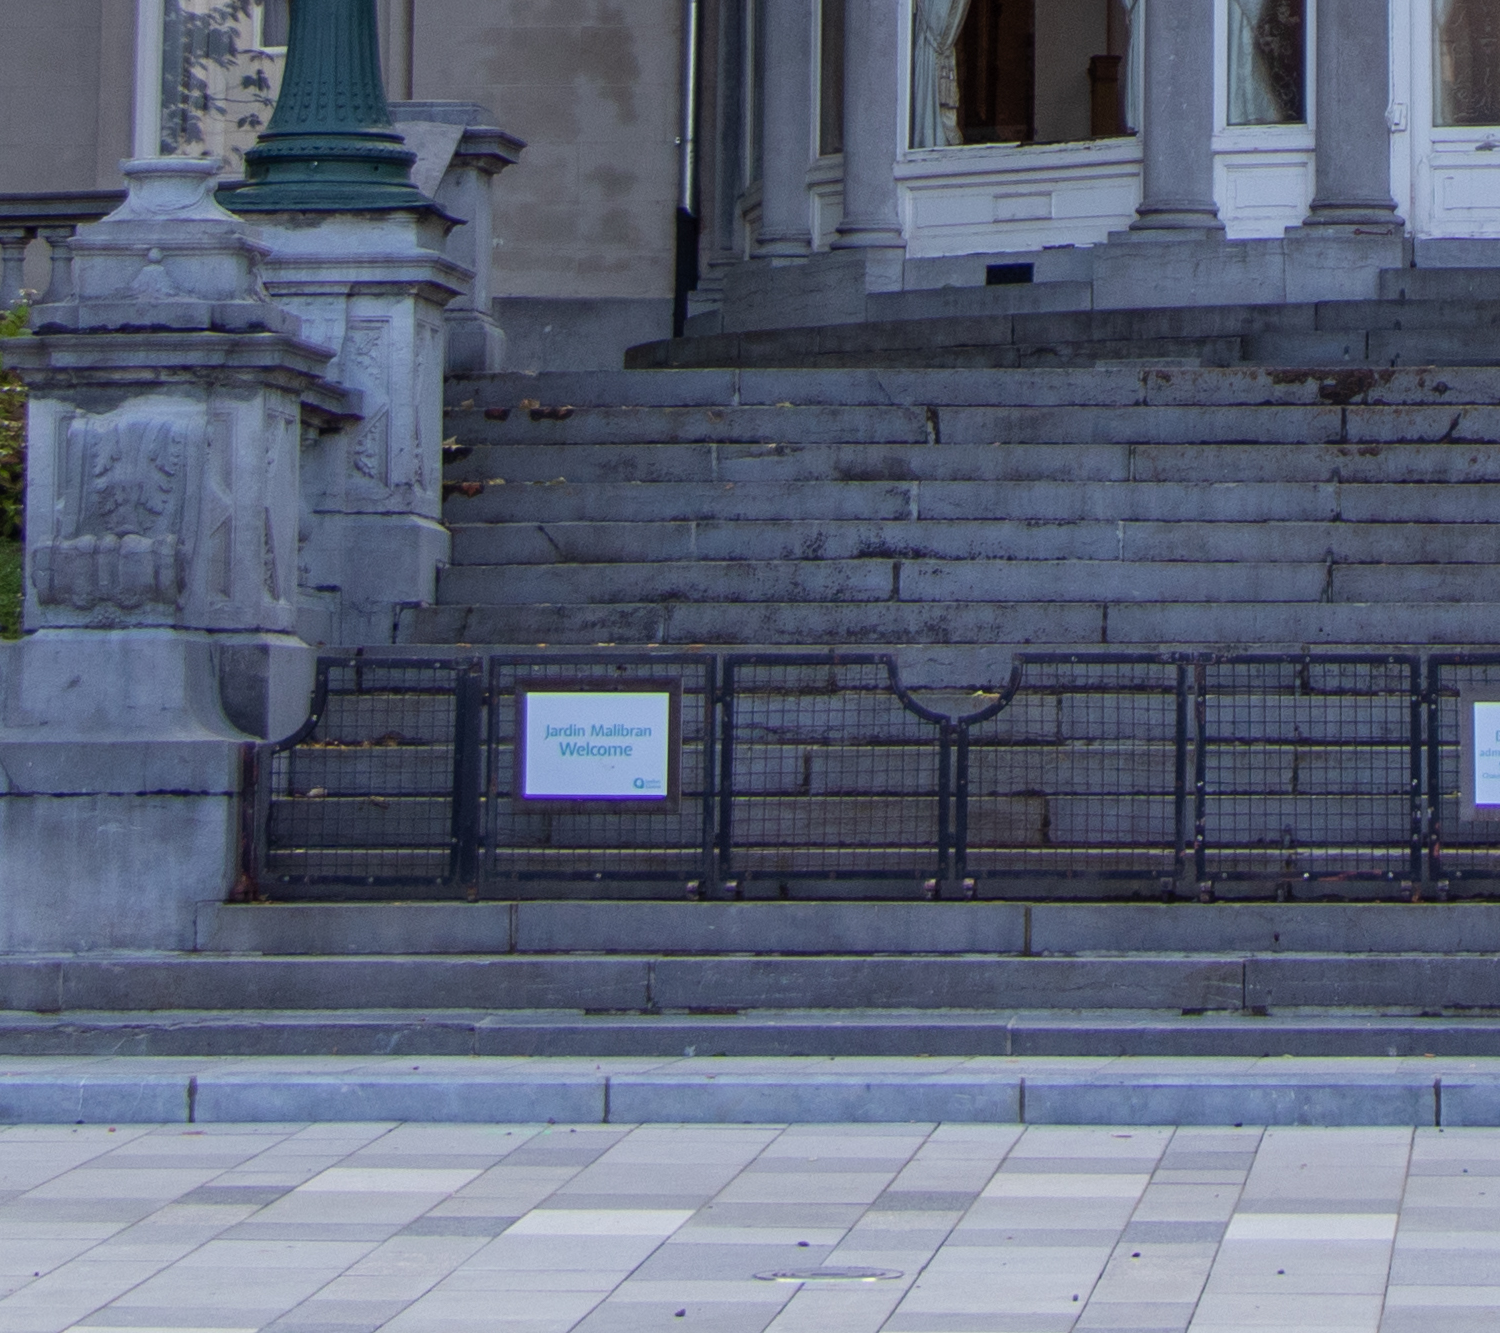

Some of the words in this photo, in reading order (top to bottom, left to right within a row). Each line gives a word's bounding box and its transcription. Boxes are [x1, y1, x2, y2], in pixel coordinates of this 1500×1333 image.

[544, 724, 586, 740] Jardin
[590, 724, 652, 737] Malibran
[559, 742, 633, 757] Welcome
